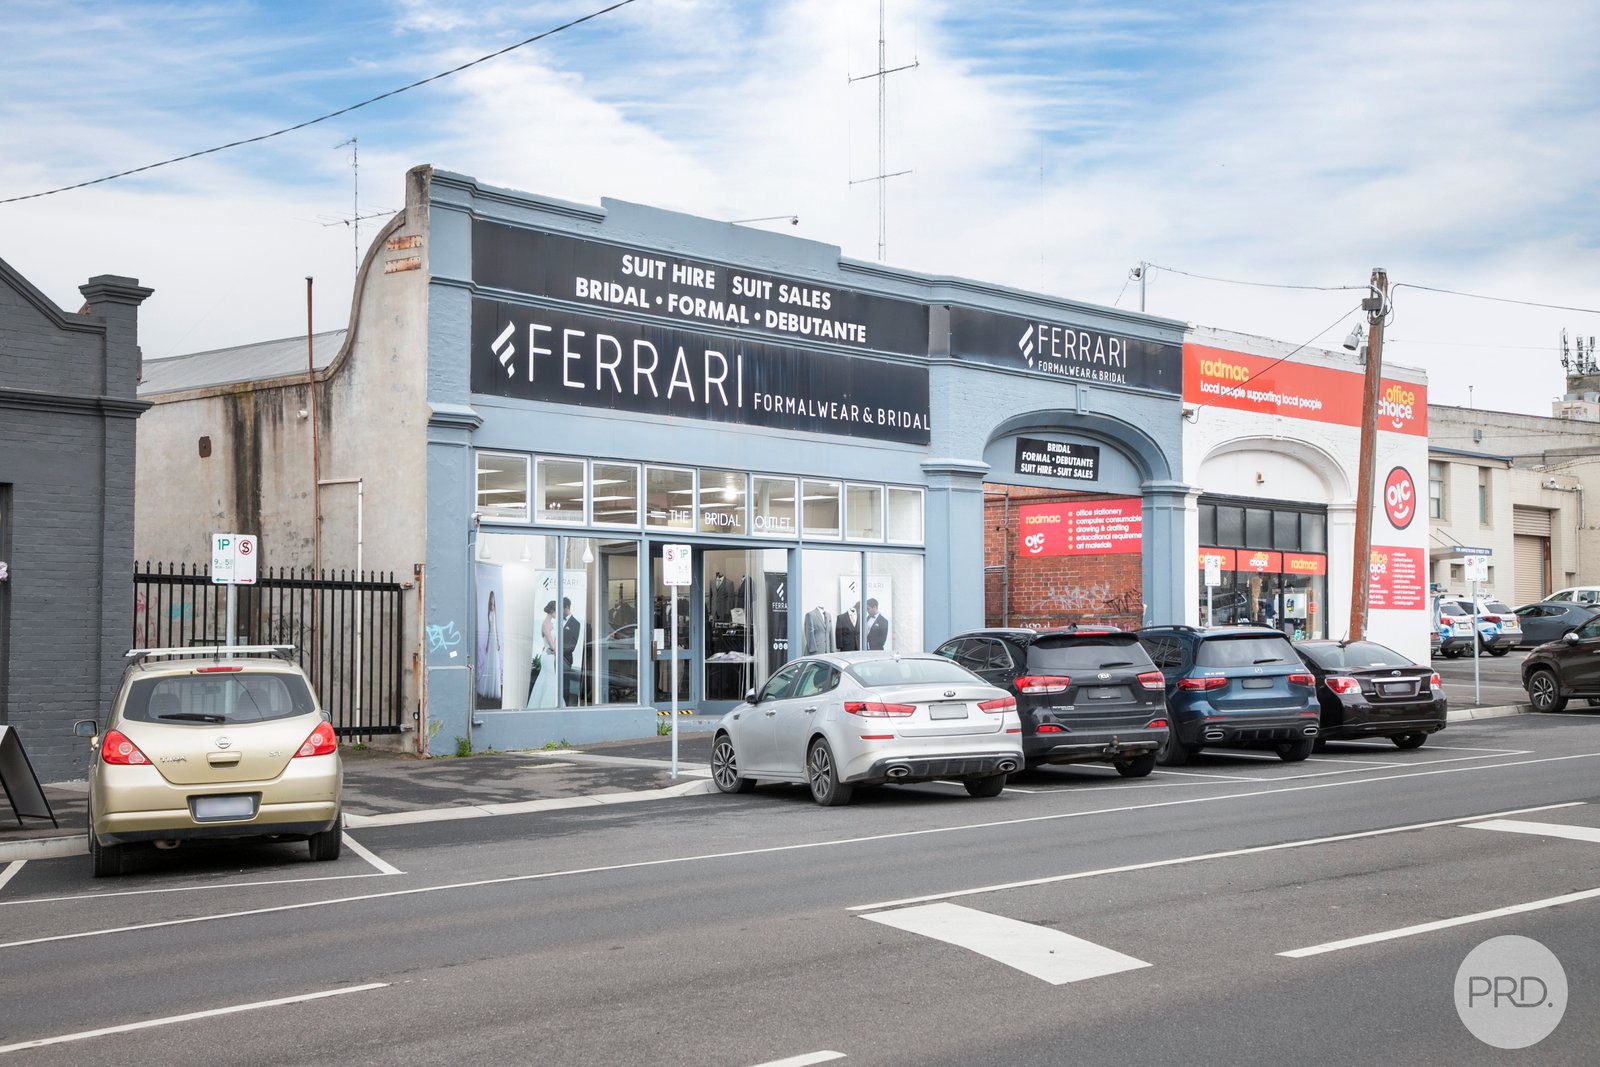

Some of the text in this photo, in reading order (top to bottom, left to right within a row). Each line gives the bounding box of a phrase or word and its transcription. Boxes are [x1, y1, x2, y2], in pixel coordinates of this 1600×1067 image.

[622, 254, 831, 310] SUIT HIRE SUIT SALES
[576, 276, 866, 342] BRIDAL FORMAL DEBUTANTE
[1038, 324, 1126, 368] FERRARI
[529, 323, 742, 408] FERRARI
[1038, 360, 1090, 378] FORMALWEAR
[1099, 371, 1126, 384] BRIDAL
[1200, 358, 1249, 382] radmac
[1200, 380, 1322, 410] Local people supporting local people
[1386, 385, 1415, 406] office
[754, 392, 859, 422] FORMALWEAR
[878, 408, 930, 430] BRIDAL
[1047, 443, 1071, 453] BRIDAL
[1021, 463, 1093, 478] SUIT HIRE SUIT SALES
[1022, 452, 1093, 467] FORMAL DEBUTANTE
[670, 509, 791, 529] THE BRIDAL OUTLET
[1026, 514, 1061, 524] radmac
[218, 539, 230, 550] 1P
[1291, 558, 1317, 570] radmac
